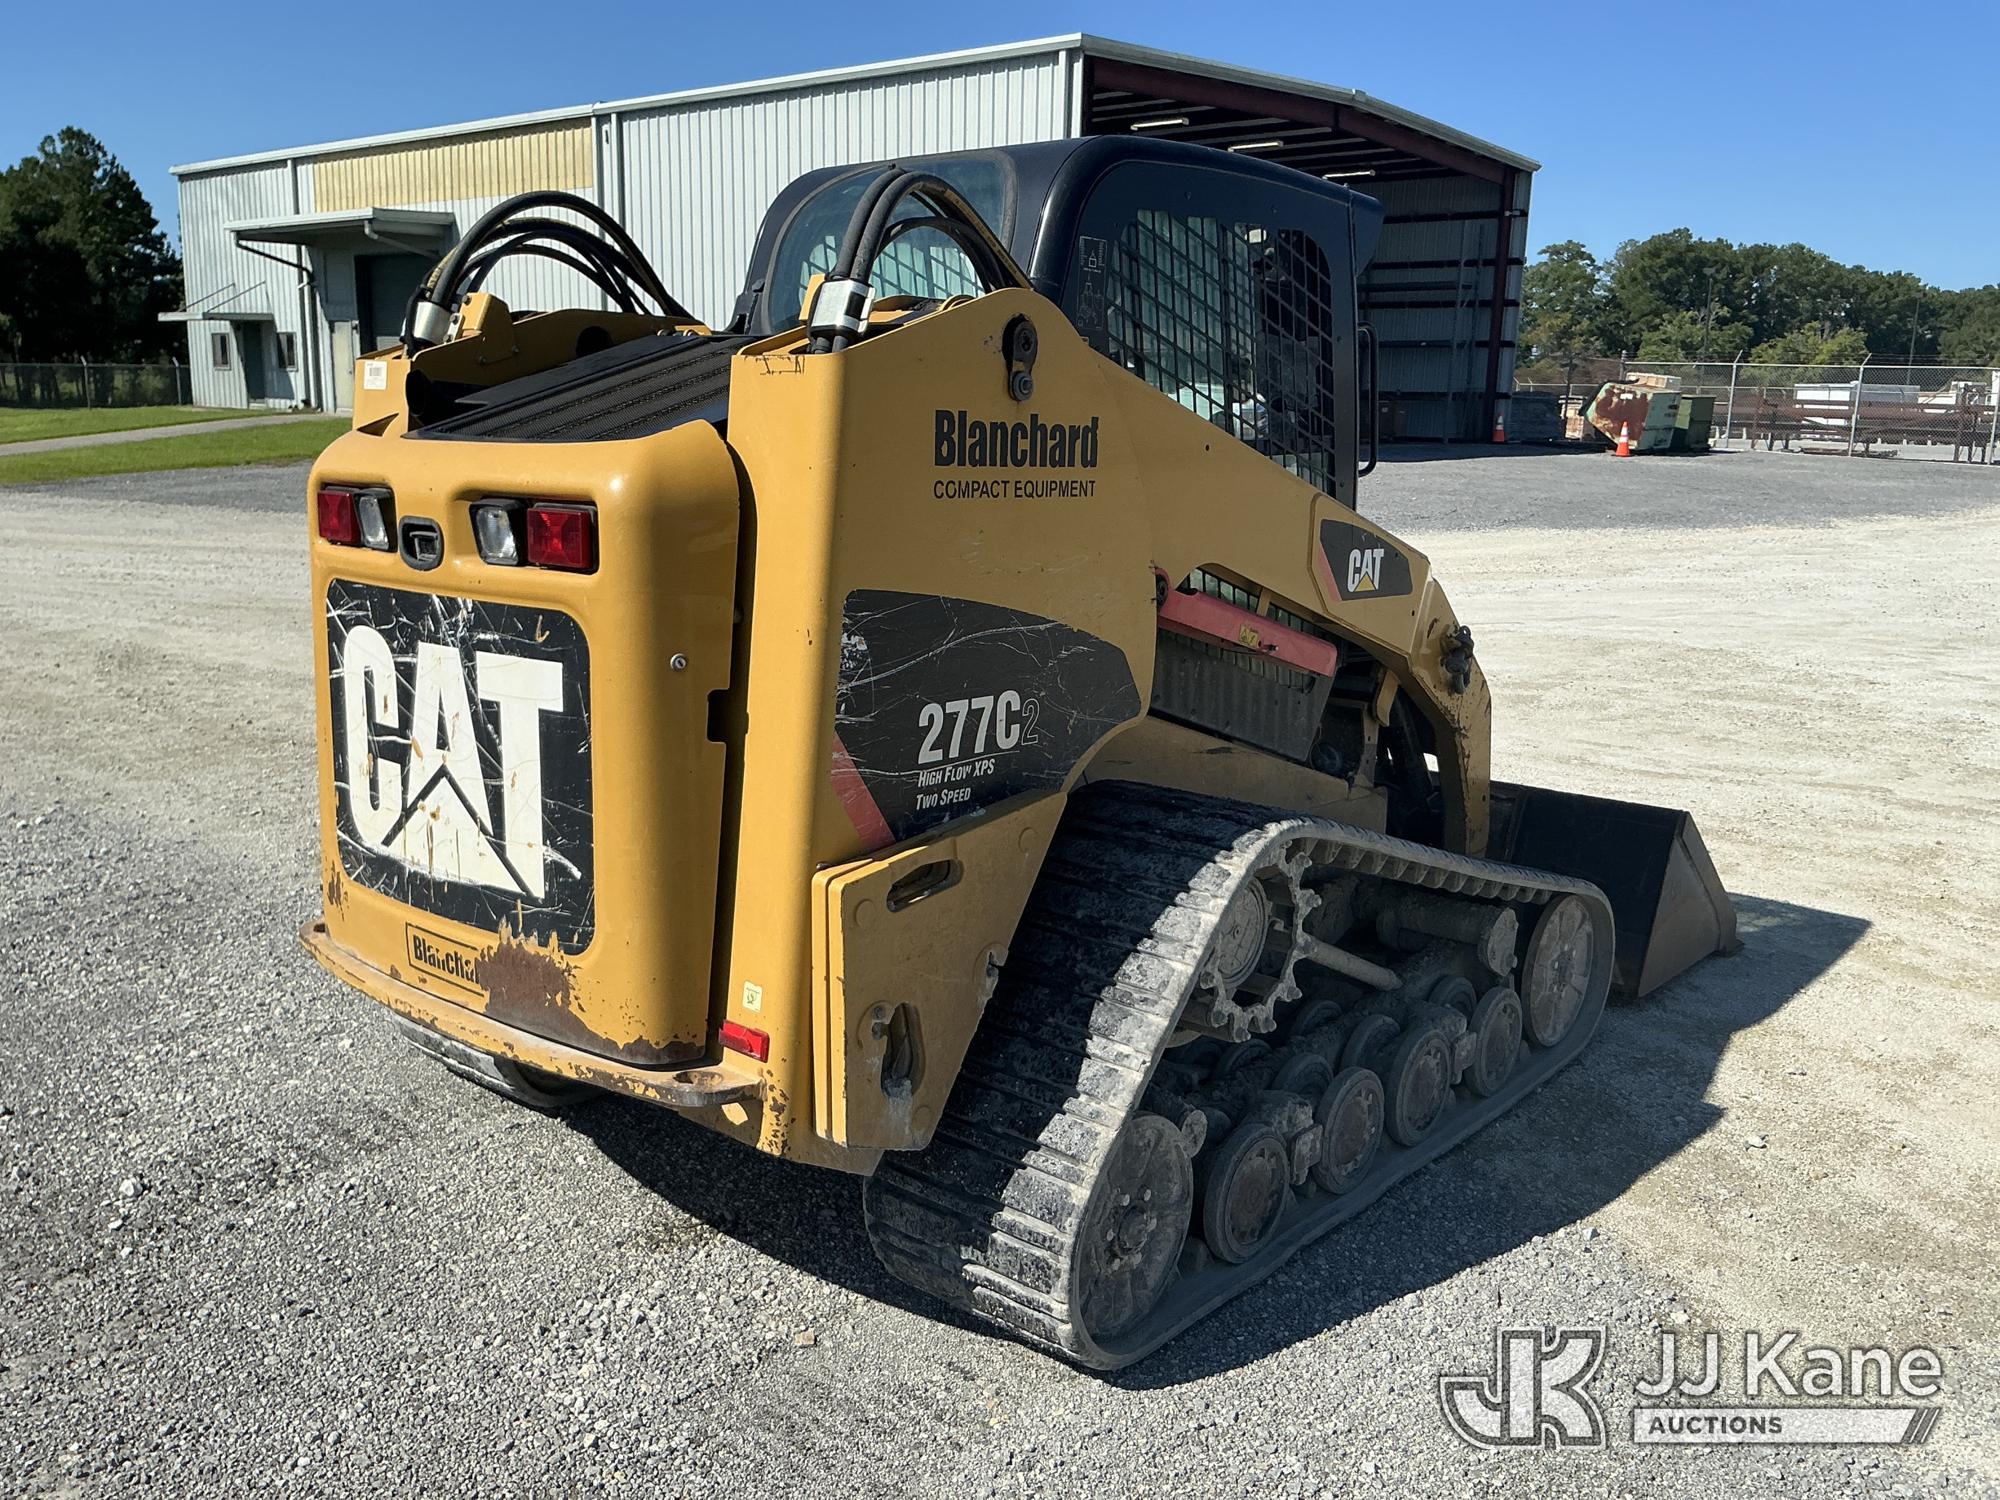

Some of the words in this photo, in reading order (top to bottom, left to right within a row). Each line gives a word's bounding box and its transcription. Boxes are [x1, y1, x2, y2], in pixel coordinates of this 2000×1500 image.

[934, 409, 1099, 468] Blanchard
[933, 480, 1010, 499] COMPACT
[1014, 480, 1096, 498] EQUIPMENT
[1347, 548, 1385, 592] CAT
[343, 624, 564, 899] CAT
[973, 758, 996, 777] XPS
